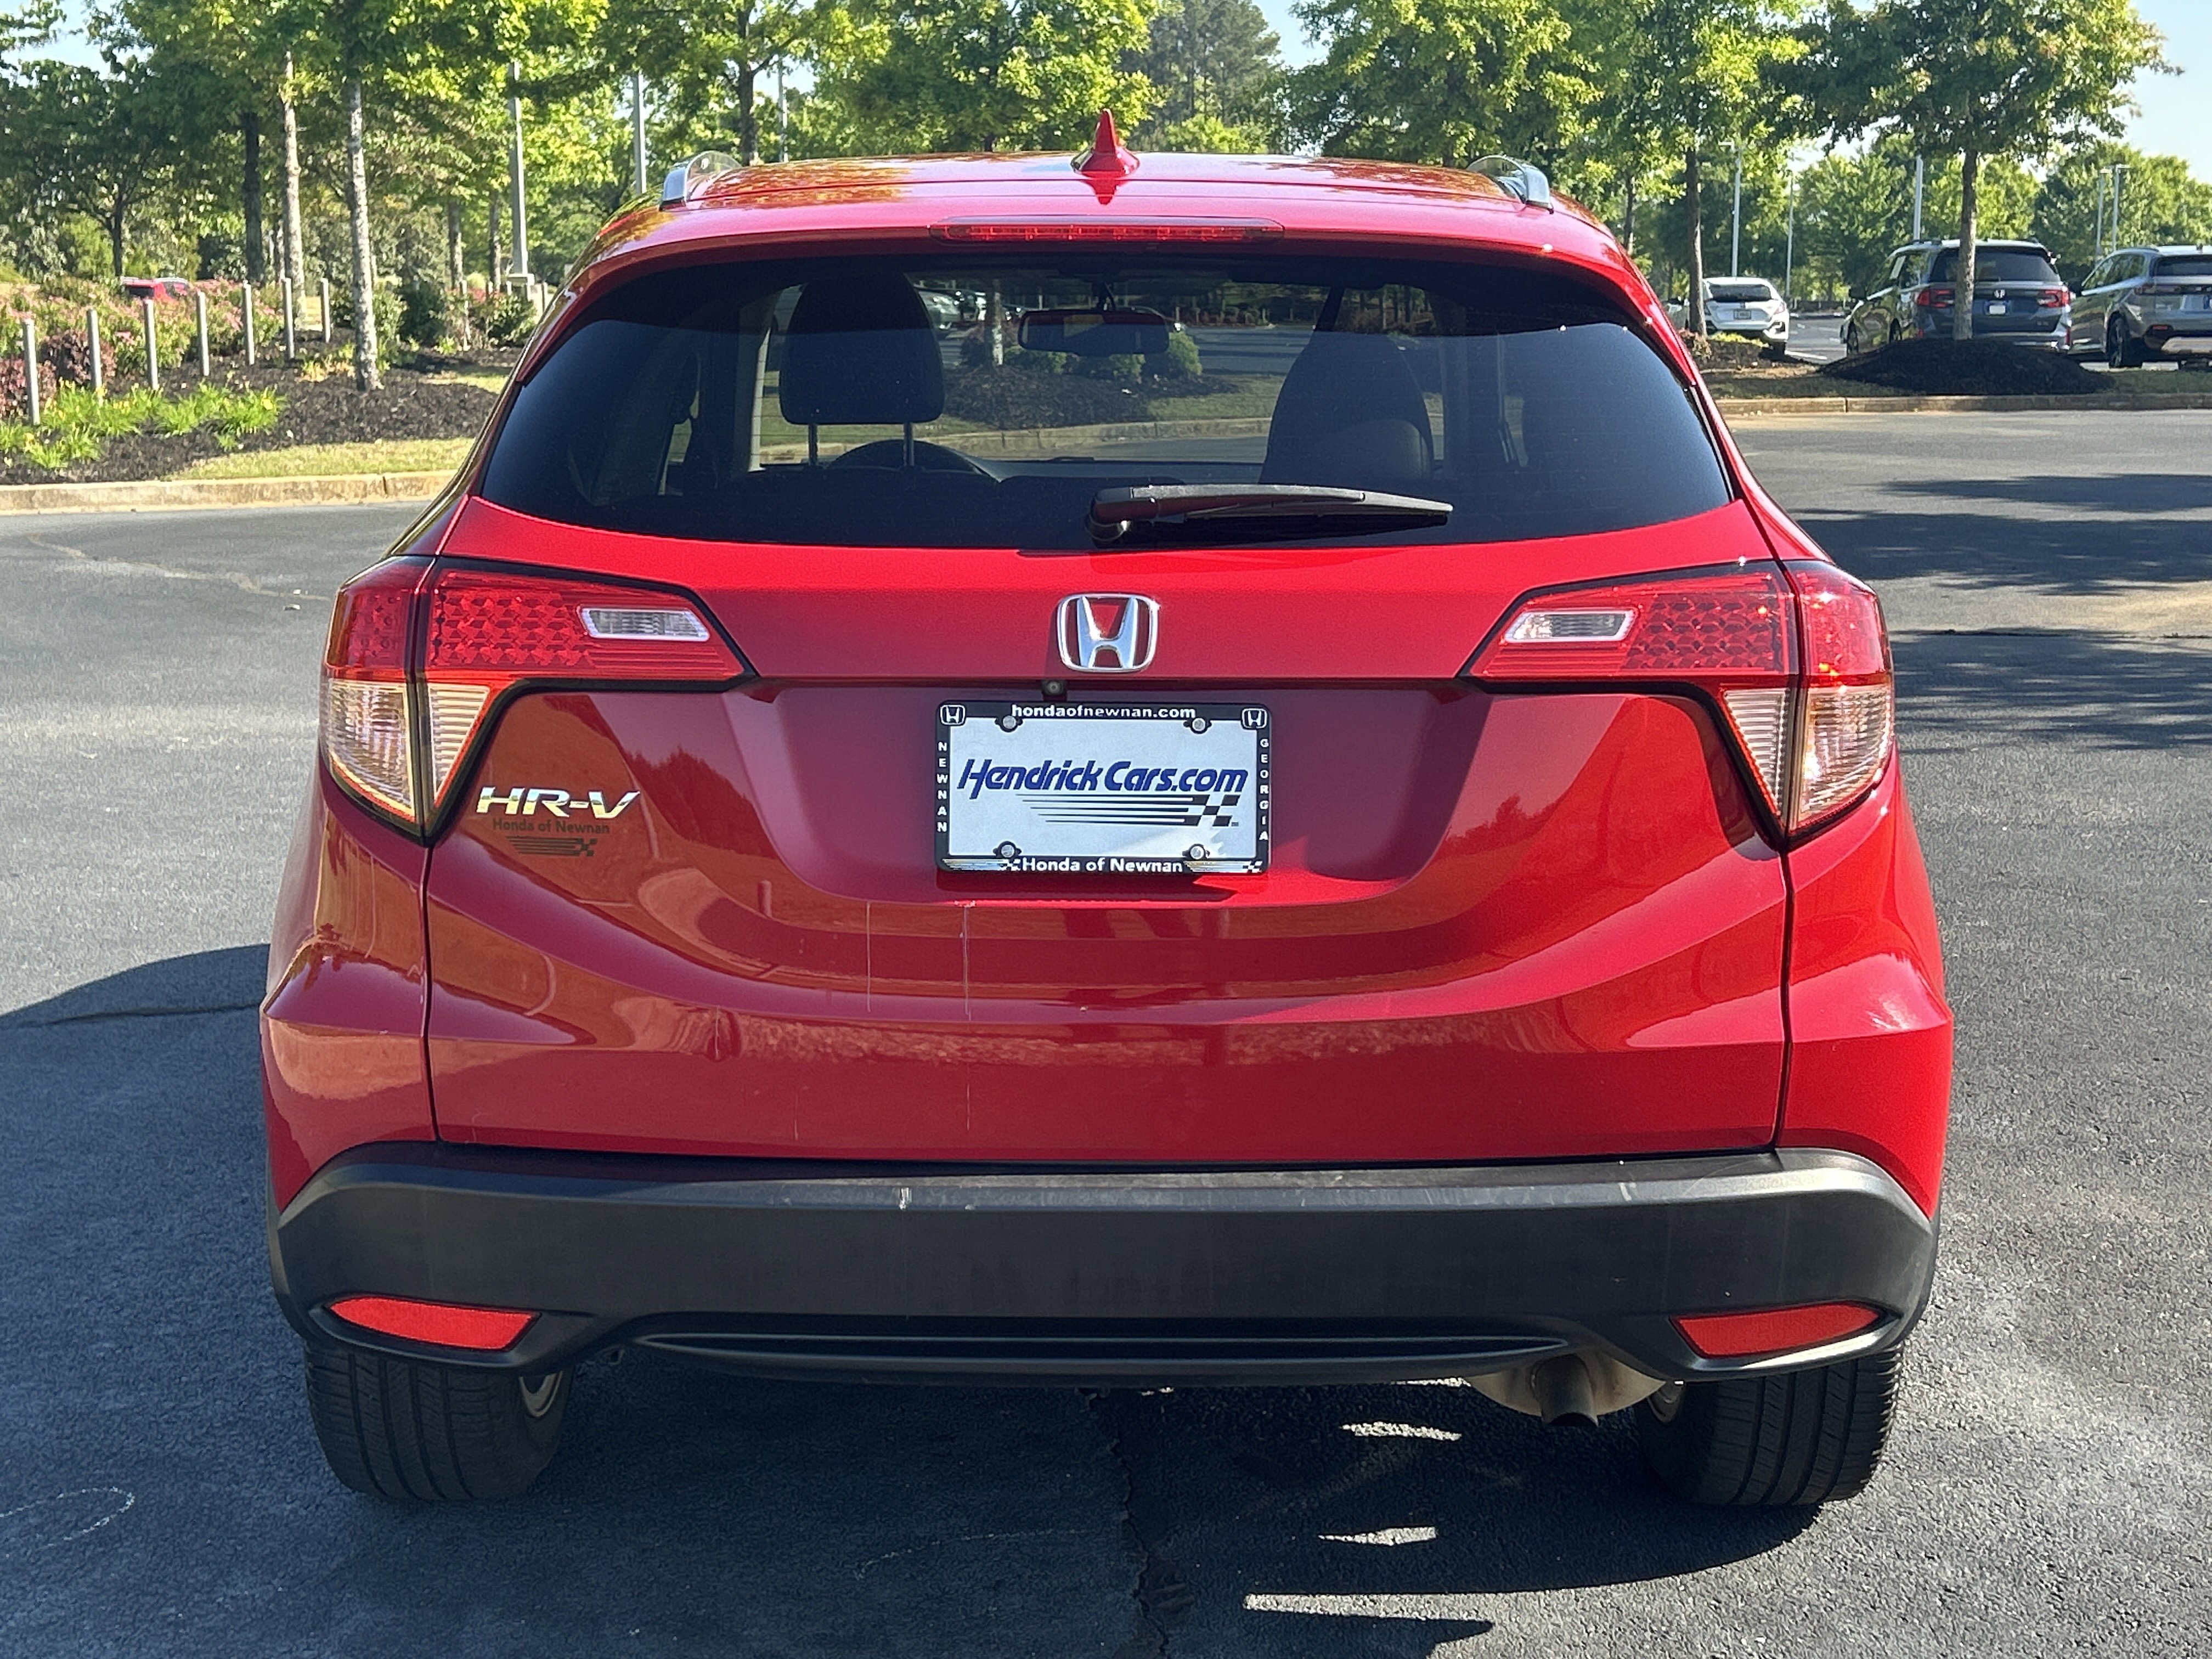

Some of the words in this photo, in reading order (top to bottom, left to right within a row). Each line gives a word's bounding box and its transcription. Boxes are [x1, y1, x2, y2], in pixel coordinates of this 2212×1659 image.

[1012, 704, 1196, 718] hondaofnewnan.com
[937, 742, 948, 832] NEWNAN
[1259, 739, 1269, 840] GEORGIA
[476, 787, 641, 819] HR-V
[493, 818, 534, 831] Honda
[538, 819, 551, 832] of
[555, 820, 610, 834] Newnan
[1022, 857, 1080, 871] Honda
[1086, 857, 1105, 872] of
[1110, 857, 1183, 872] Newnan
